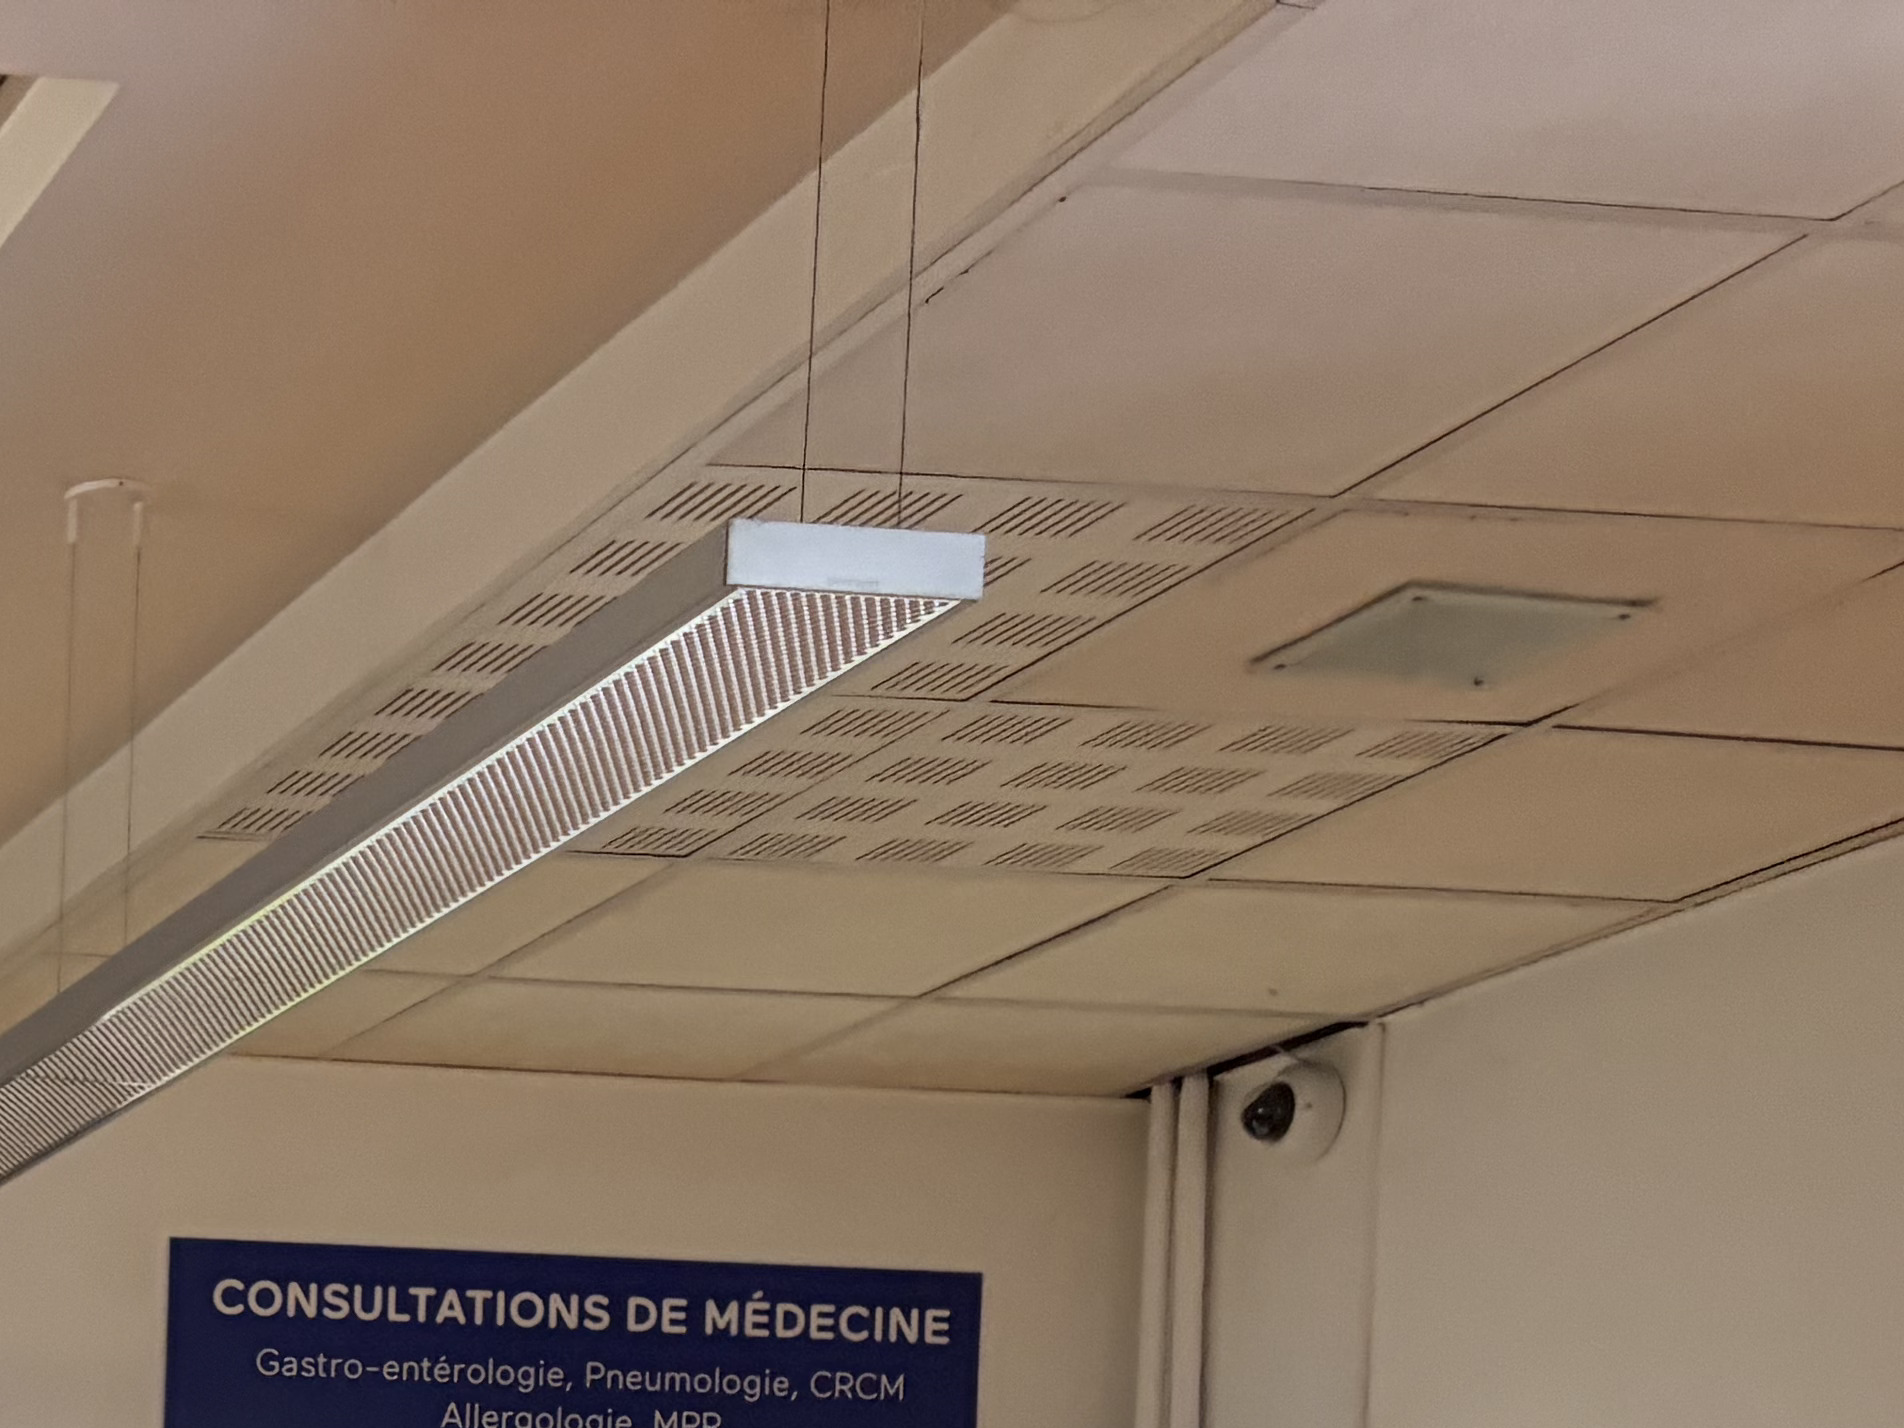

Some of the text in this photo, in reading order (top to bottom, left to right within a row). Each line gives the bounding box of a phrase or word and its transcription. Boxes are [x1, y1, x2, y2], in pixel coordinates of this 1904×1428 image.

[212, 1278, 952, 1345] CONSULTATIONS DE MÉDECINE
[255, 1347, 906, 1402] Gastro-entérologie, Pneumologie, CRCM
